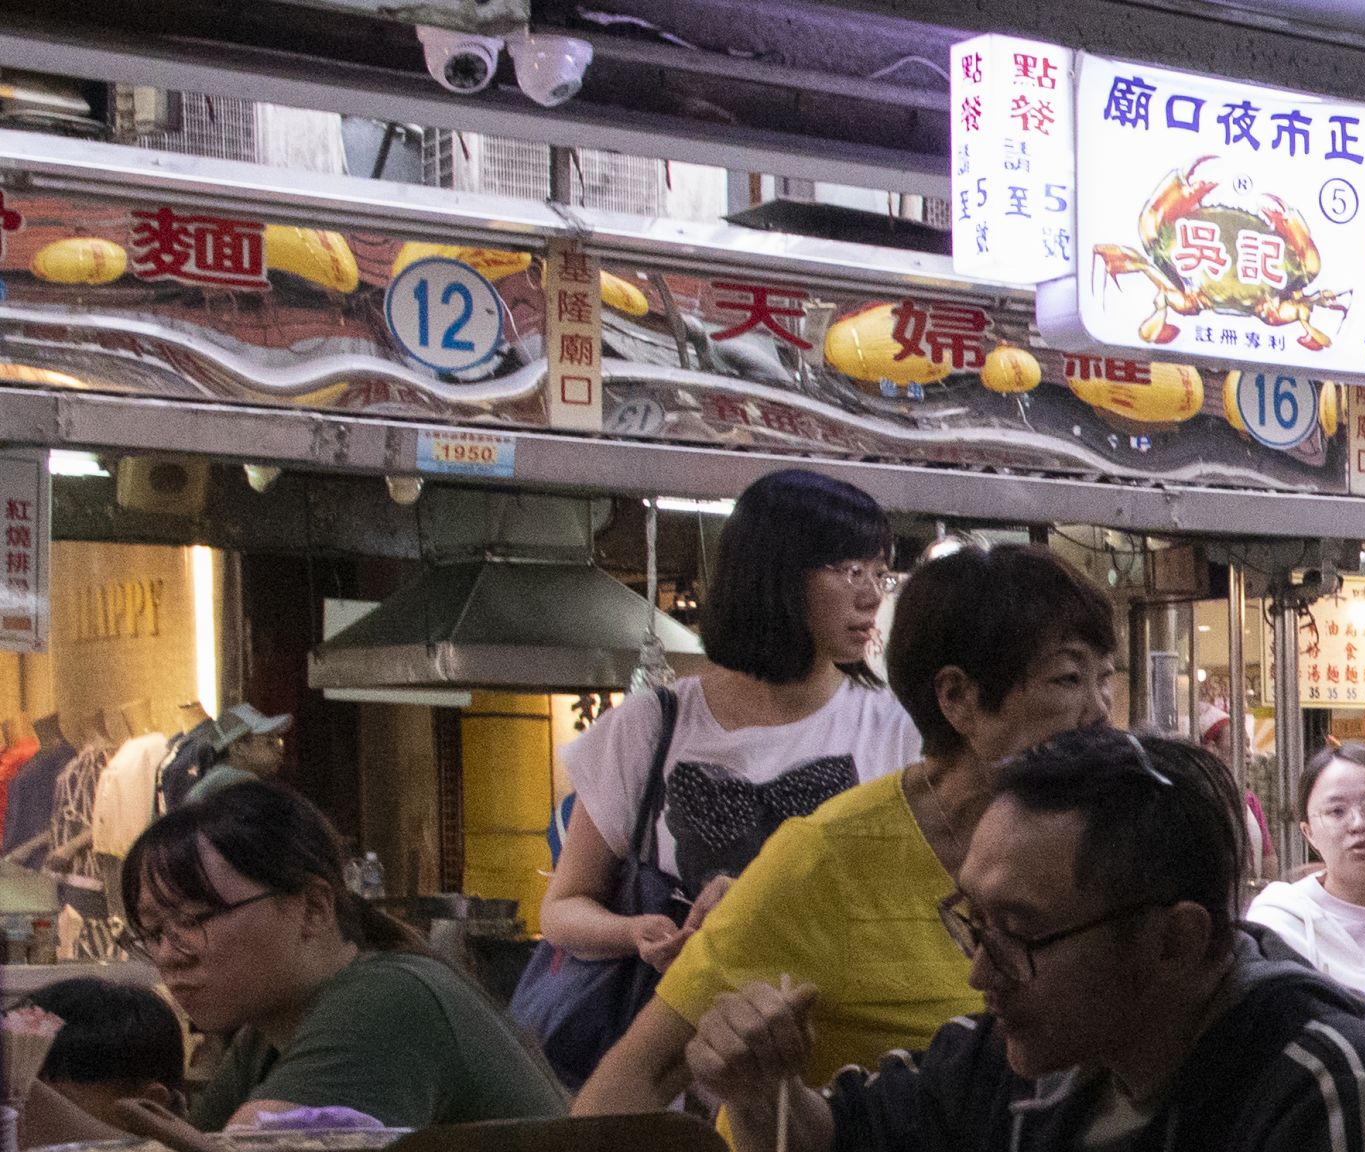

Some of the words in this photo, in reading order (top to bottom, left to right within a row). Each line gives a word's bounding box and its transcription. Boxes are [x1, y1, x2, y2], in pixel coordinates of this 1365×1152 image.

[1173, 222, 1285, 285] 吳記
[413, 277, 475, 352] 12
[558, 245, 594, 405] 基隆廟口
[1255, 373, 1300, 430] 16
